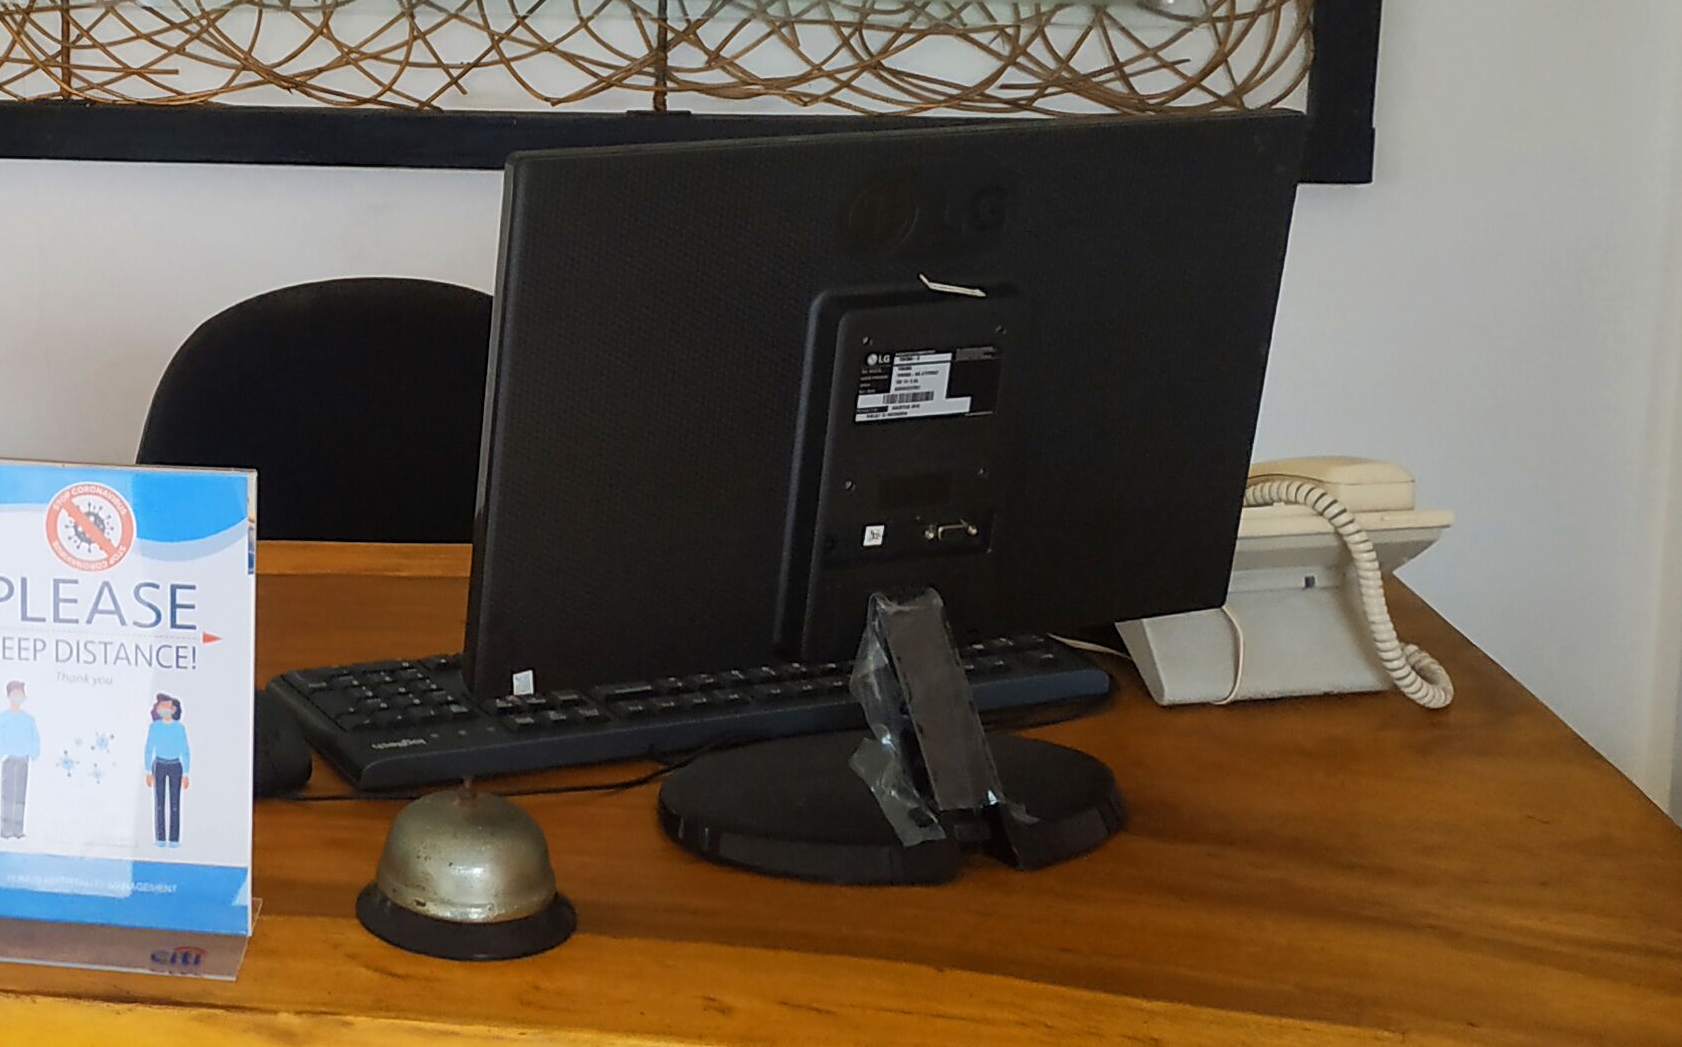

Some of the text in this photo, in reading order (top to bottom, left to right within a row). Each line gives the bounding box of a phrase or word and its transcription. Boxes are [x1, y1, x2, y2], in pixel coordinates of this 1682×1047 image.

[878, 355, 891, 364] LG
[54, 638, 197, 670] DISTANCE!
[56, 671, 114, 687] Thank you
